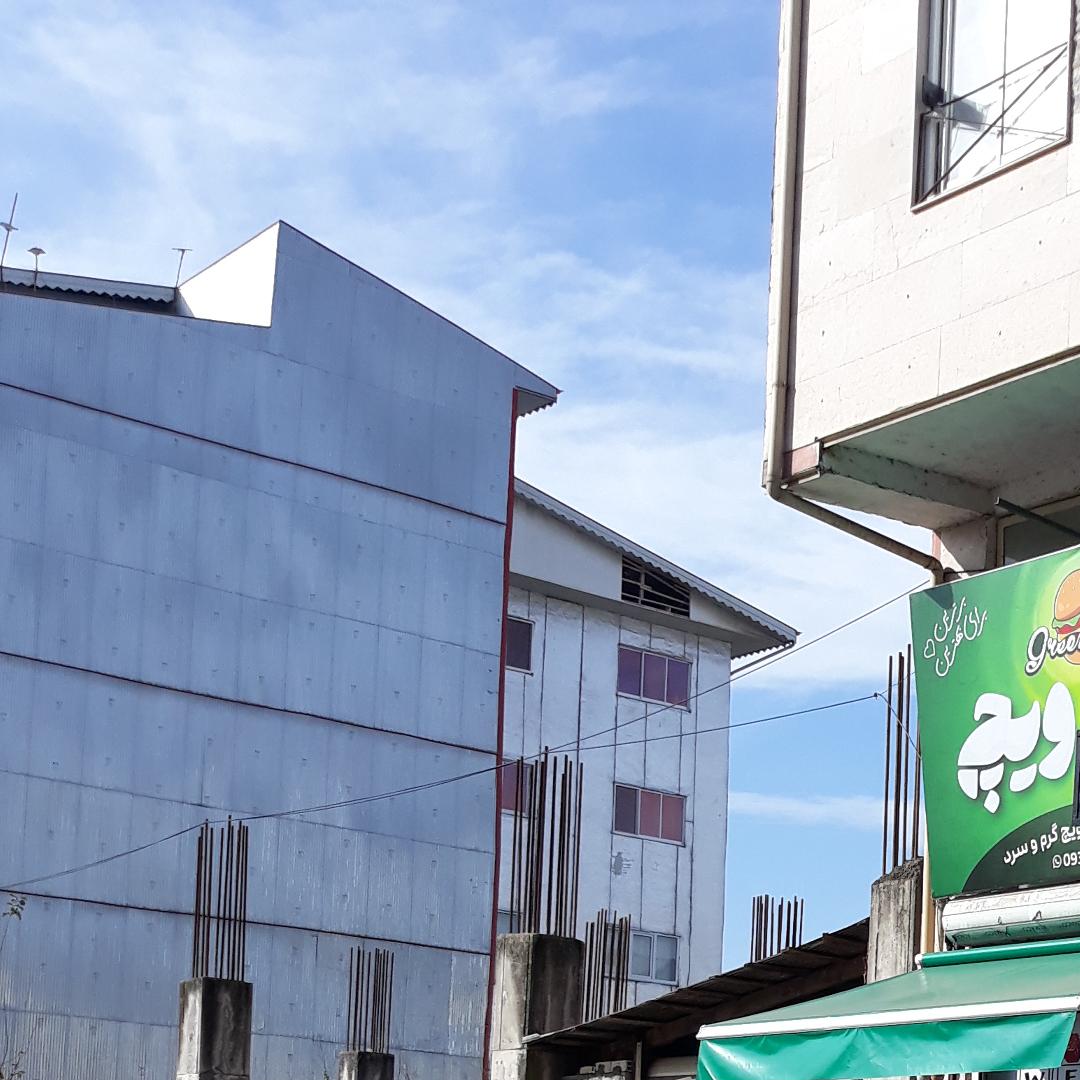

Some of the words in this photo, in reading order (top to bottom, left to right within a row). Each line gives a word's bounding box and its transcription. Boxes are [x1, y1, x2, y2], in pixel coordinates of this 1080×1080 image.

[956, 680, 1077, 815] ویچ
[1030, 838, 1039, 855] و
[1040, 823, 1059, 853] گرم
[1003, 842, 1029, 866] سرد
